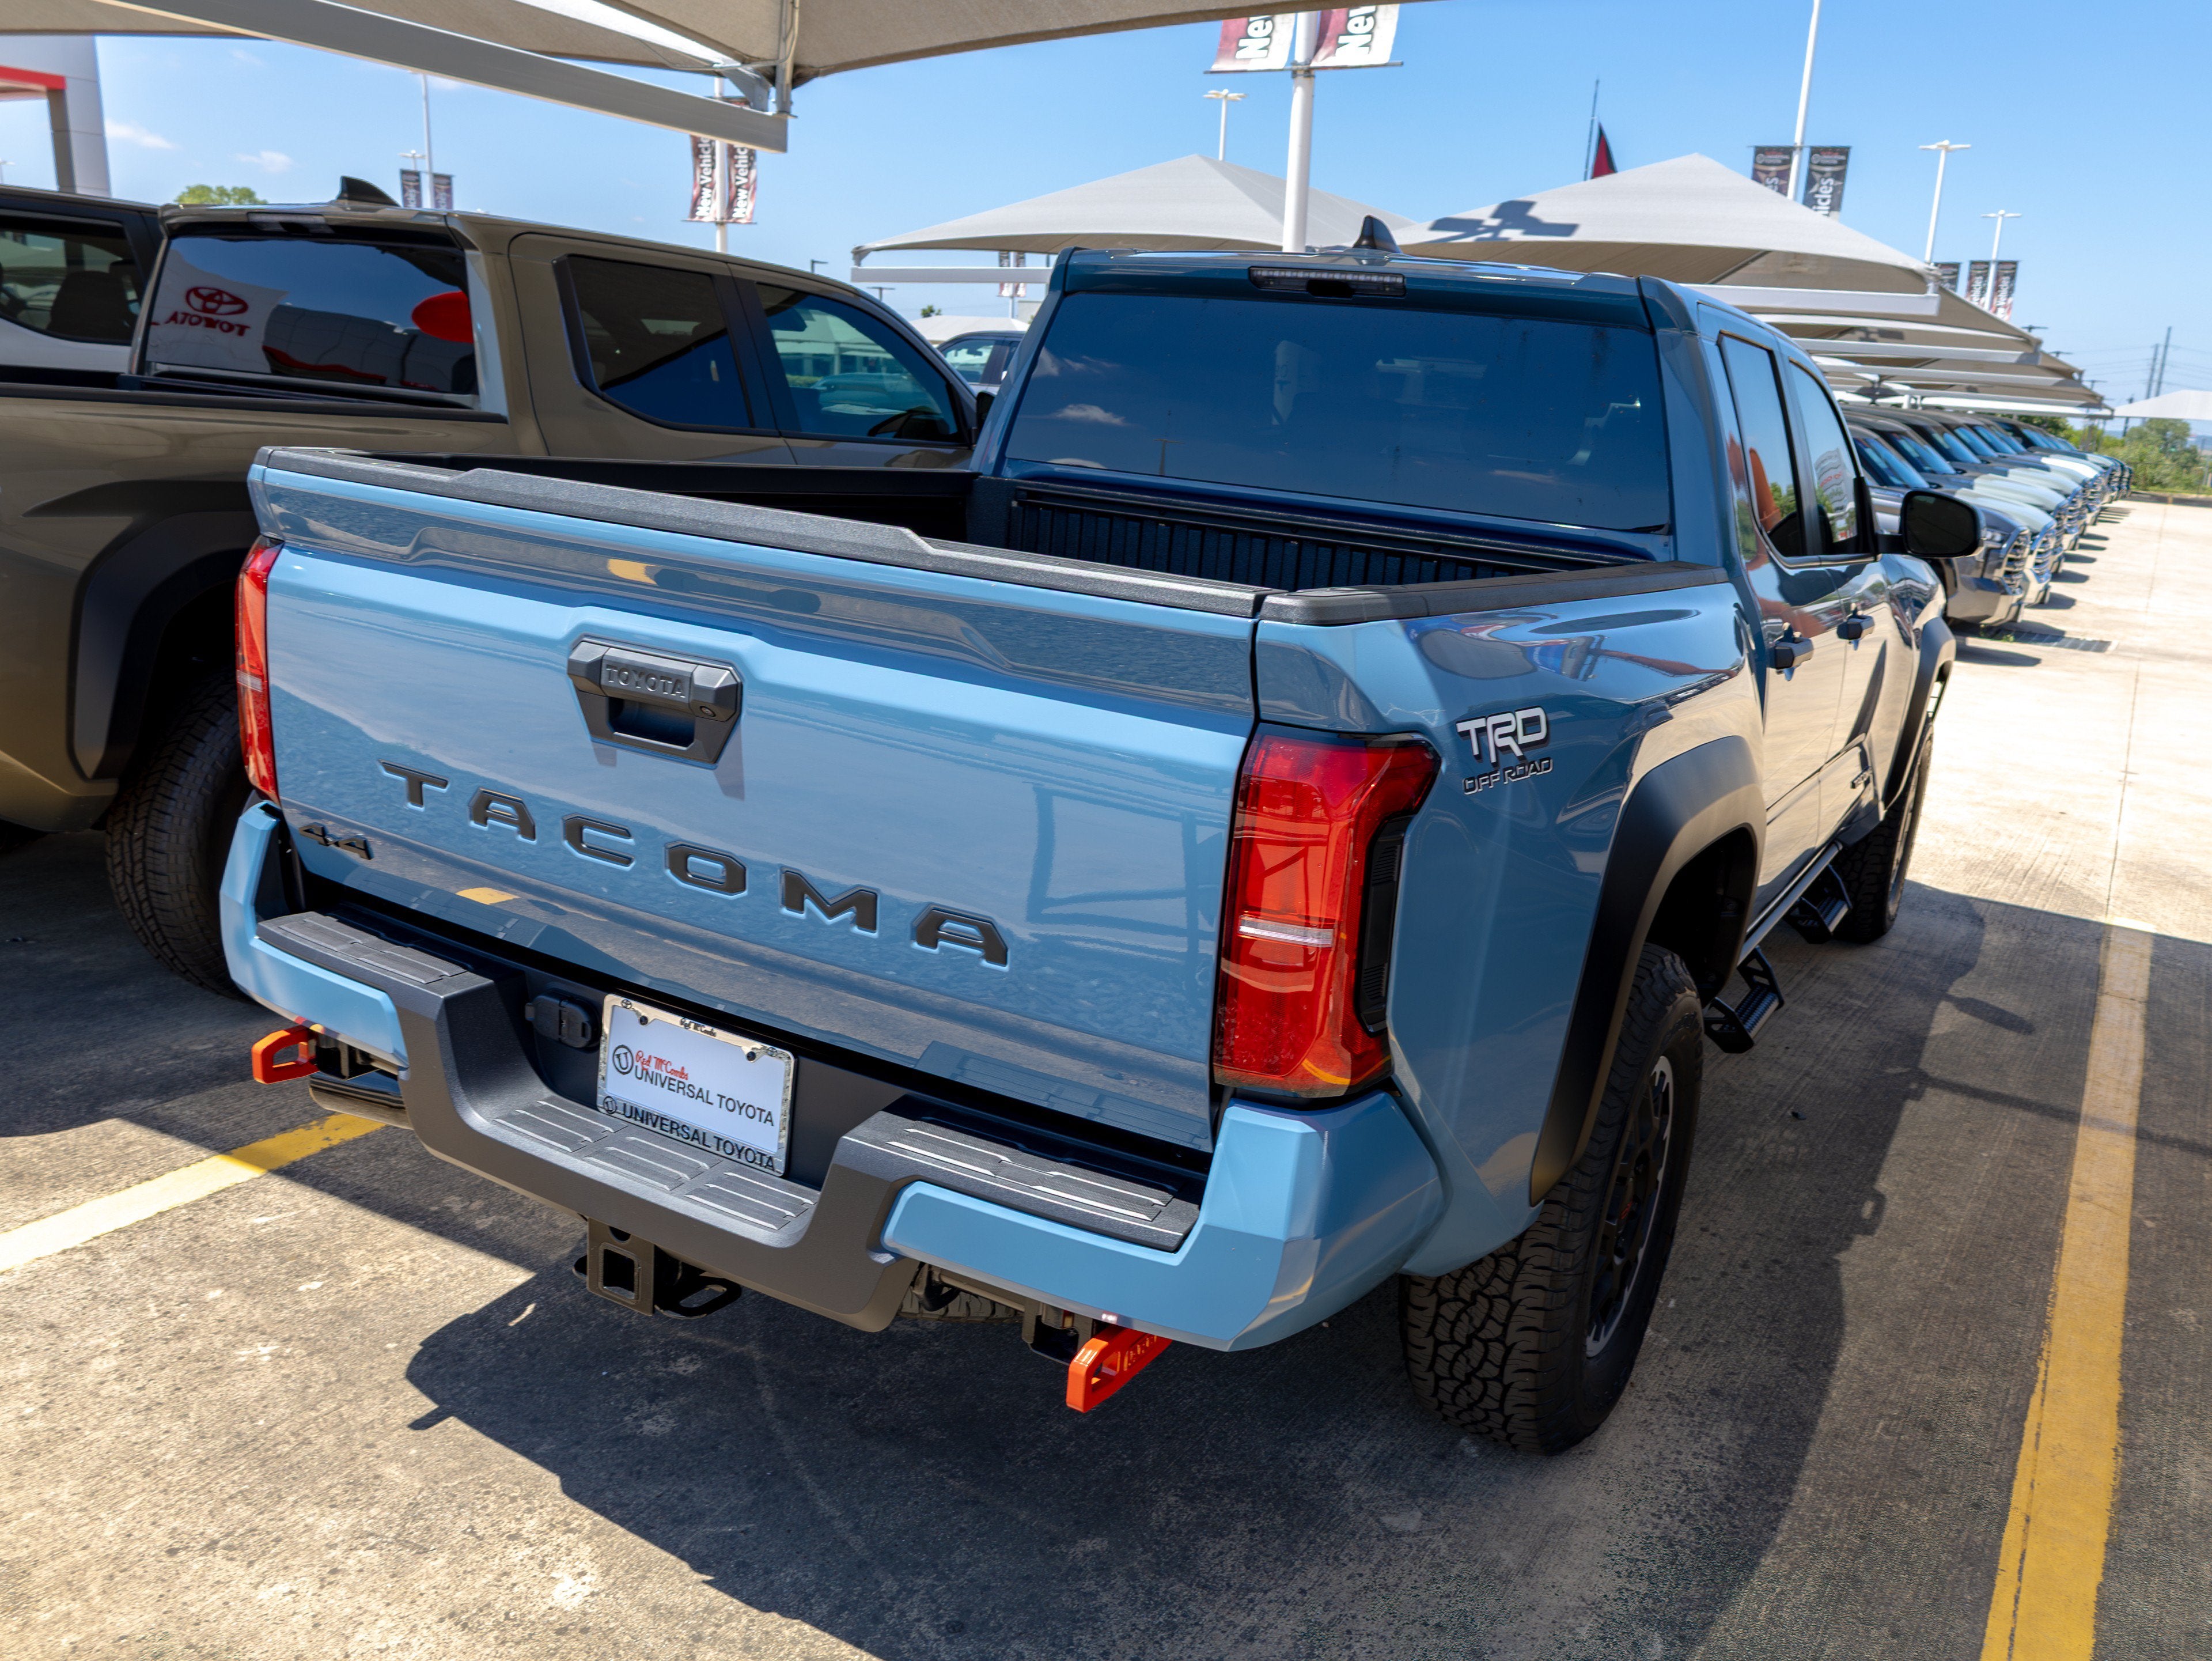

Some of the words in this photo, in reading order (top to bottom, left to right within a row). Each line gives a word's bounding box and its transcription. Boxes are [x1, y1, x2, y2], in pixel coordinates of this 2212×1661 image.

[1235, 16, 1273, 59] Ne
[695, 187, 712, 216] New
[732, 188, 748, 218] New
[605, 664, 686, 698] TOYOTA
[1456, 706, 1548, 767] TRD
[1462, 770, 1500, 795] OFF
[1503, 756, 1553, 784] ROAD
[378, 759, 1009, 971] TACOMA
[635, 1050, 652, 1067] Red
[635, 1065, 714, 1106] UNIVERSAL
[717, 1094, 774, 1126] TOYOTA
[623, 1103, 711, 1148] UNIVERSAL
[714, 1135, 777, 1171] TOYOTA
